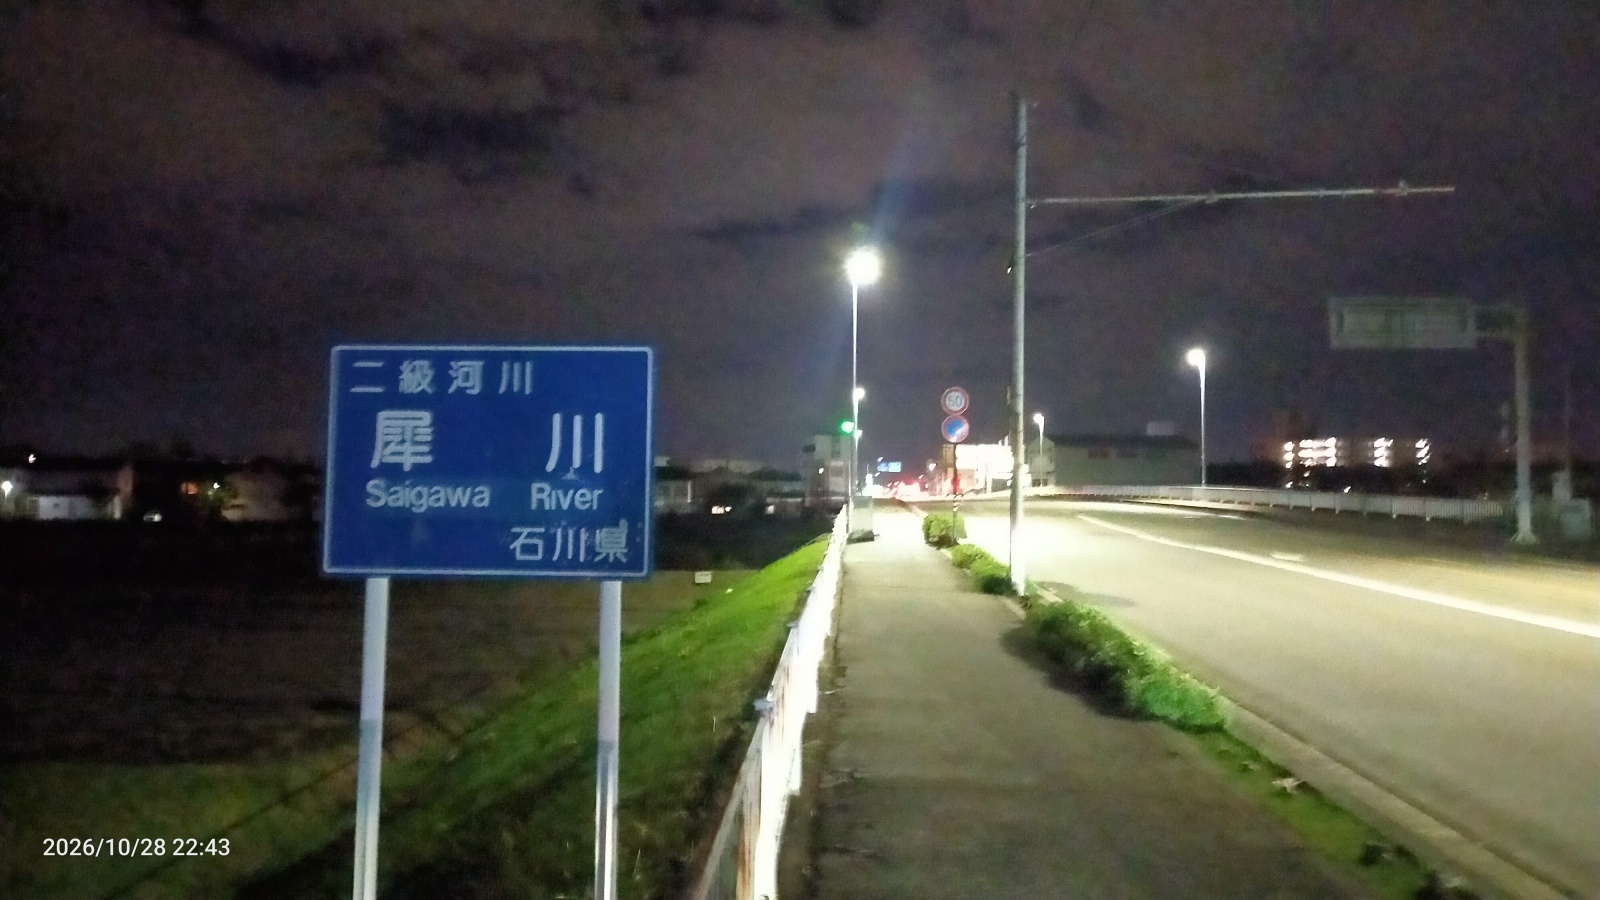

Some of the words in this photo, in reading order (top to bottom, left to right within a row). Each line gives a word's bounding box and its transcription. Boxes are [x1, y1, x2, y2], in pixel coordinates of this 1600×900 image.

[351, 360, 533, 394] 二級河川
[366, 479, 491, 513] Saigawa
[530, 482, 603, 510] River
[509, 521, 628, 562] 石川県
